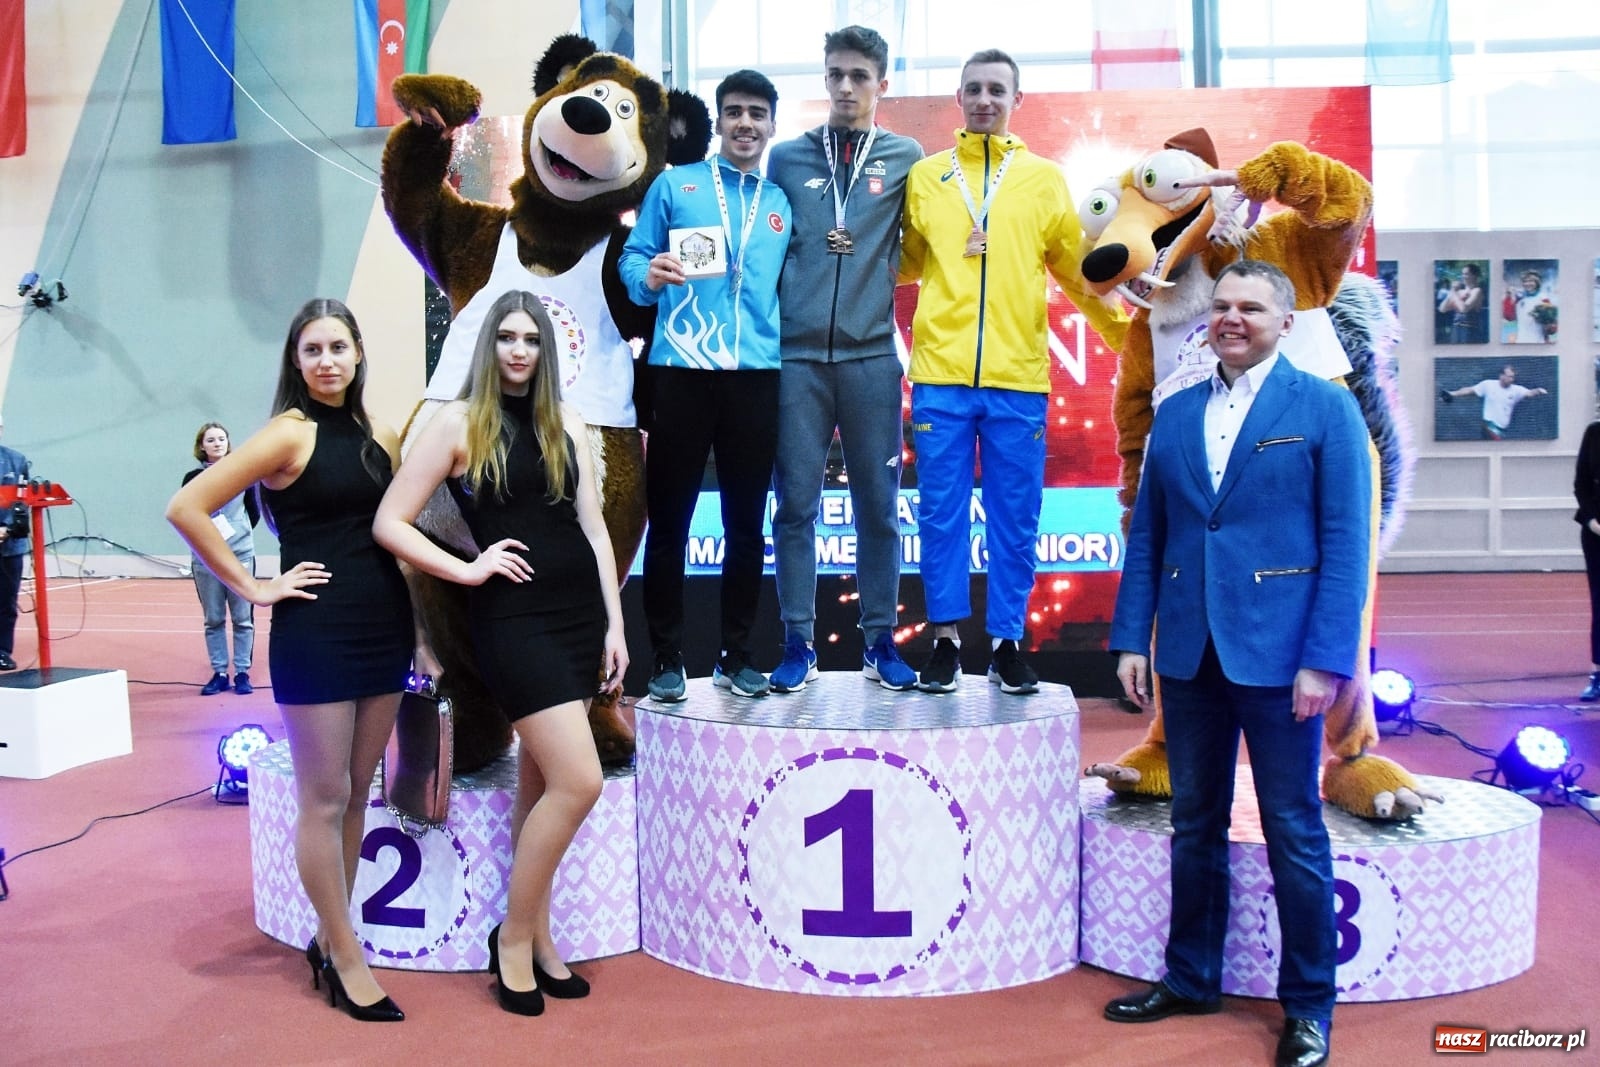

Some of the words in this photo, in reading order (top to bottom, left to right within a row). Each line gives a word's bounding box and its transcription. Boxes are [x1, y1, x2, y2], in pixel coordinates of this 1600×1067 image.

[971, 533, 1119, 569] (NIOR)
[360, 827, 425, 928] 2
[802, 789, 912, 937] 1
